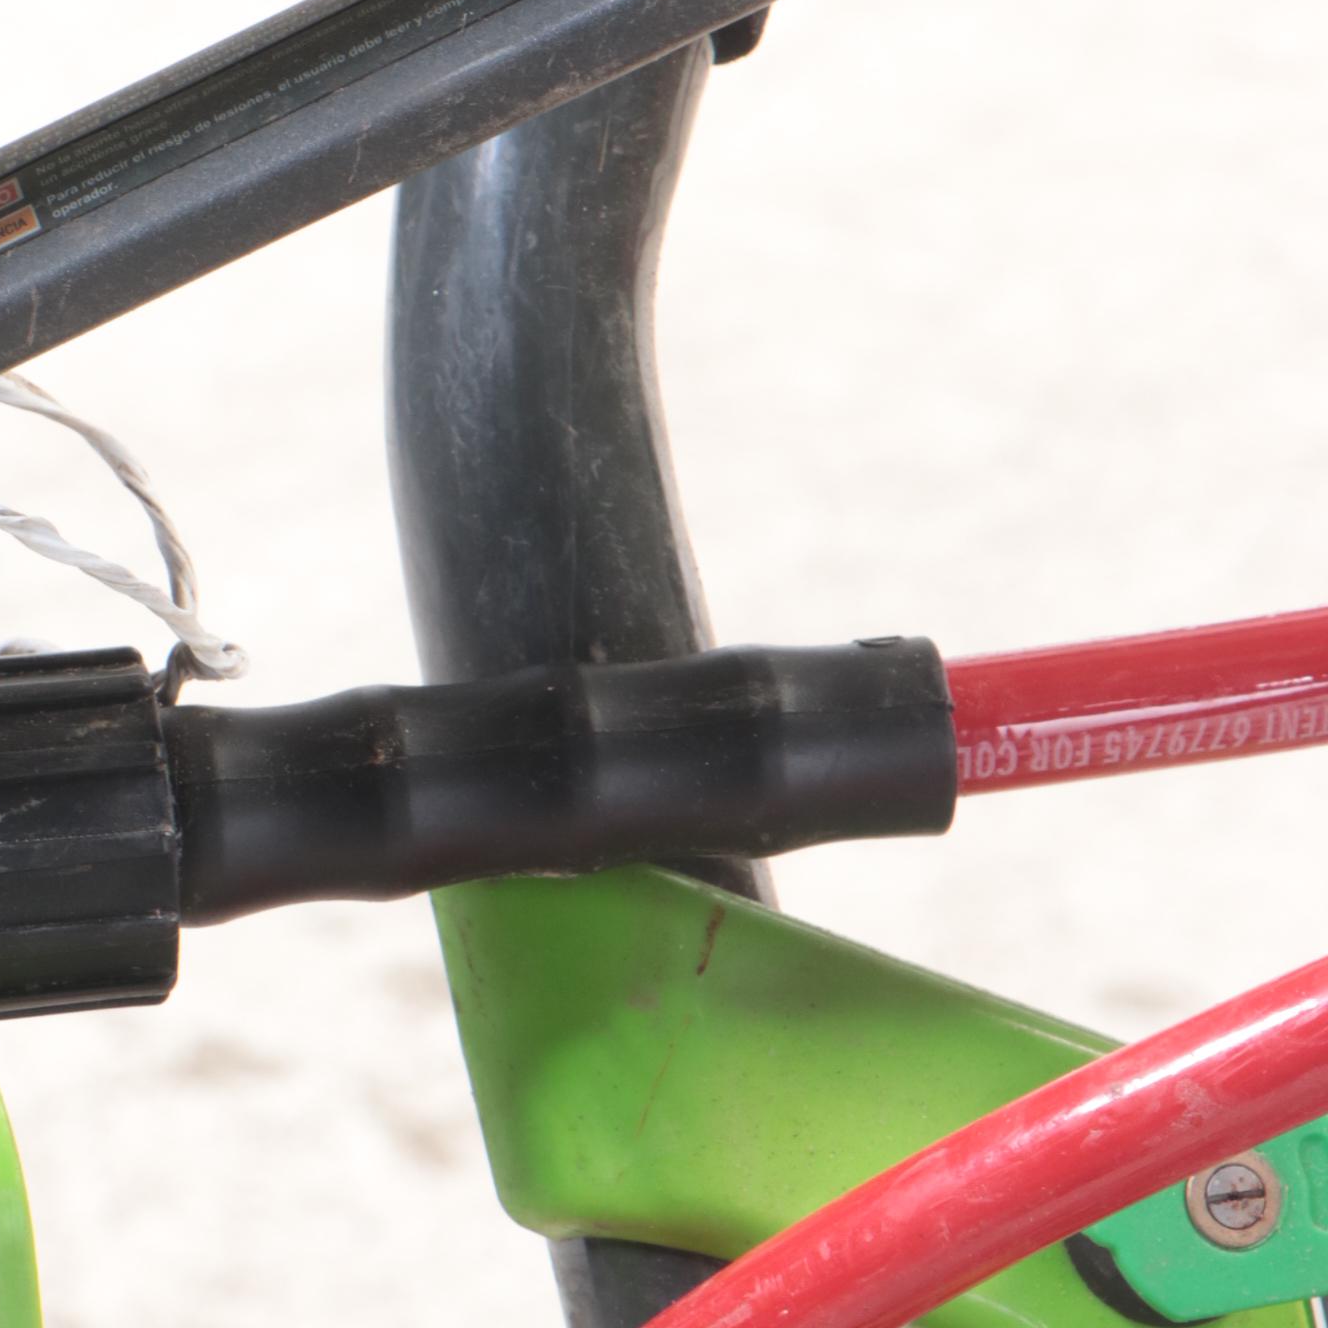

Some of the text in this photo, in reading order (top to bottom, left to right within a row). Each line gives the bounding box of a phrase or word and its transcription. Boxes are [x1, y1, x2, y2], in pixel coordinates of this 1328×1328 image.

[46, 183, 79, 206] Para
[80, 158, 129, 189] reducir
[131, 152, 146, 165] el
[148, 130, 191, 156] riesgo
[194, 118, 212, 134] de
[278, 79, 292, 93] el
[293, 54, 346, 84] usuario
[348, 36, 383, 58] debe
[385, 21, 413, 40] leer
[51, 183, 120, 220] operador.
[1030, 734, 1093, 773] FOR
[1103, 716, 1251, 764] 6779745
